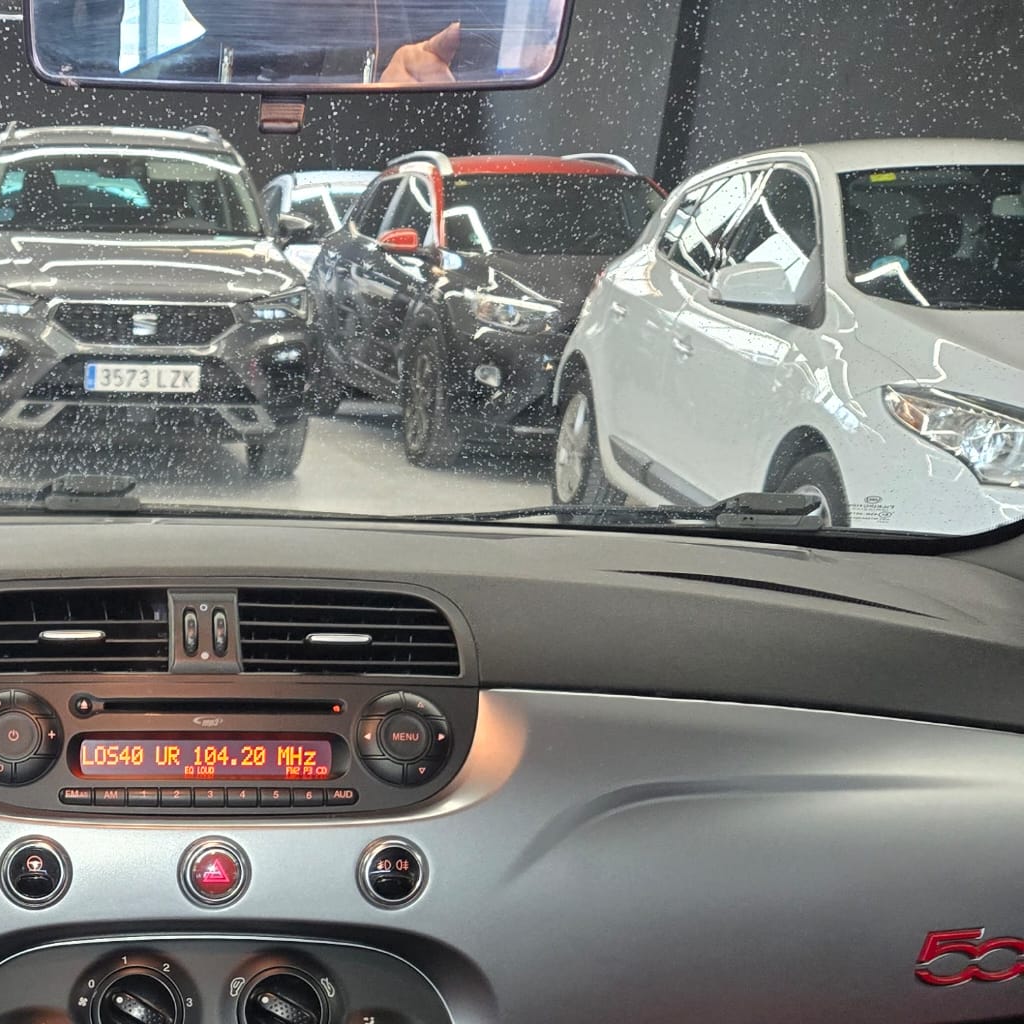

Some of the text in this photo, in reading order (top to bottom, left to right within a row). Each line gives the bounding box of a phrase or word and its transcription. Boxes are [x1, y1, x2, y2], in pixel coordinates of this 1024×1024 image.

[101, 369, 193, 388] 3573 LZK
[392, 732, 419, 741] MENU
[81, 746, 317, 766] LOS40 UR 104.20 MHz
[104, 790, 118, 799] AM
[333, 790, 353, 799] AUD
[122, 956, 128, 965] 1
[914, 927, 1024, 986] 50
[163, 963, 170, 972] 2
[88, 979, 95, 988] 0
[186, 997, 193, 1007] 3
